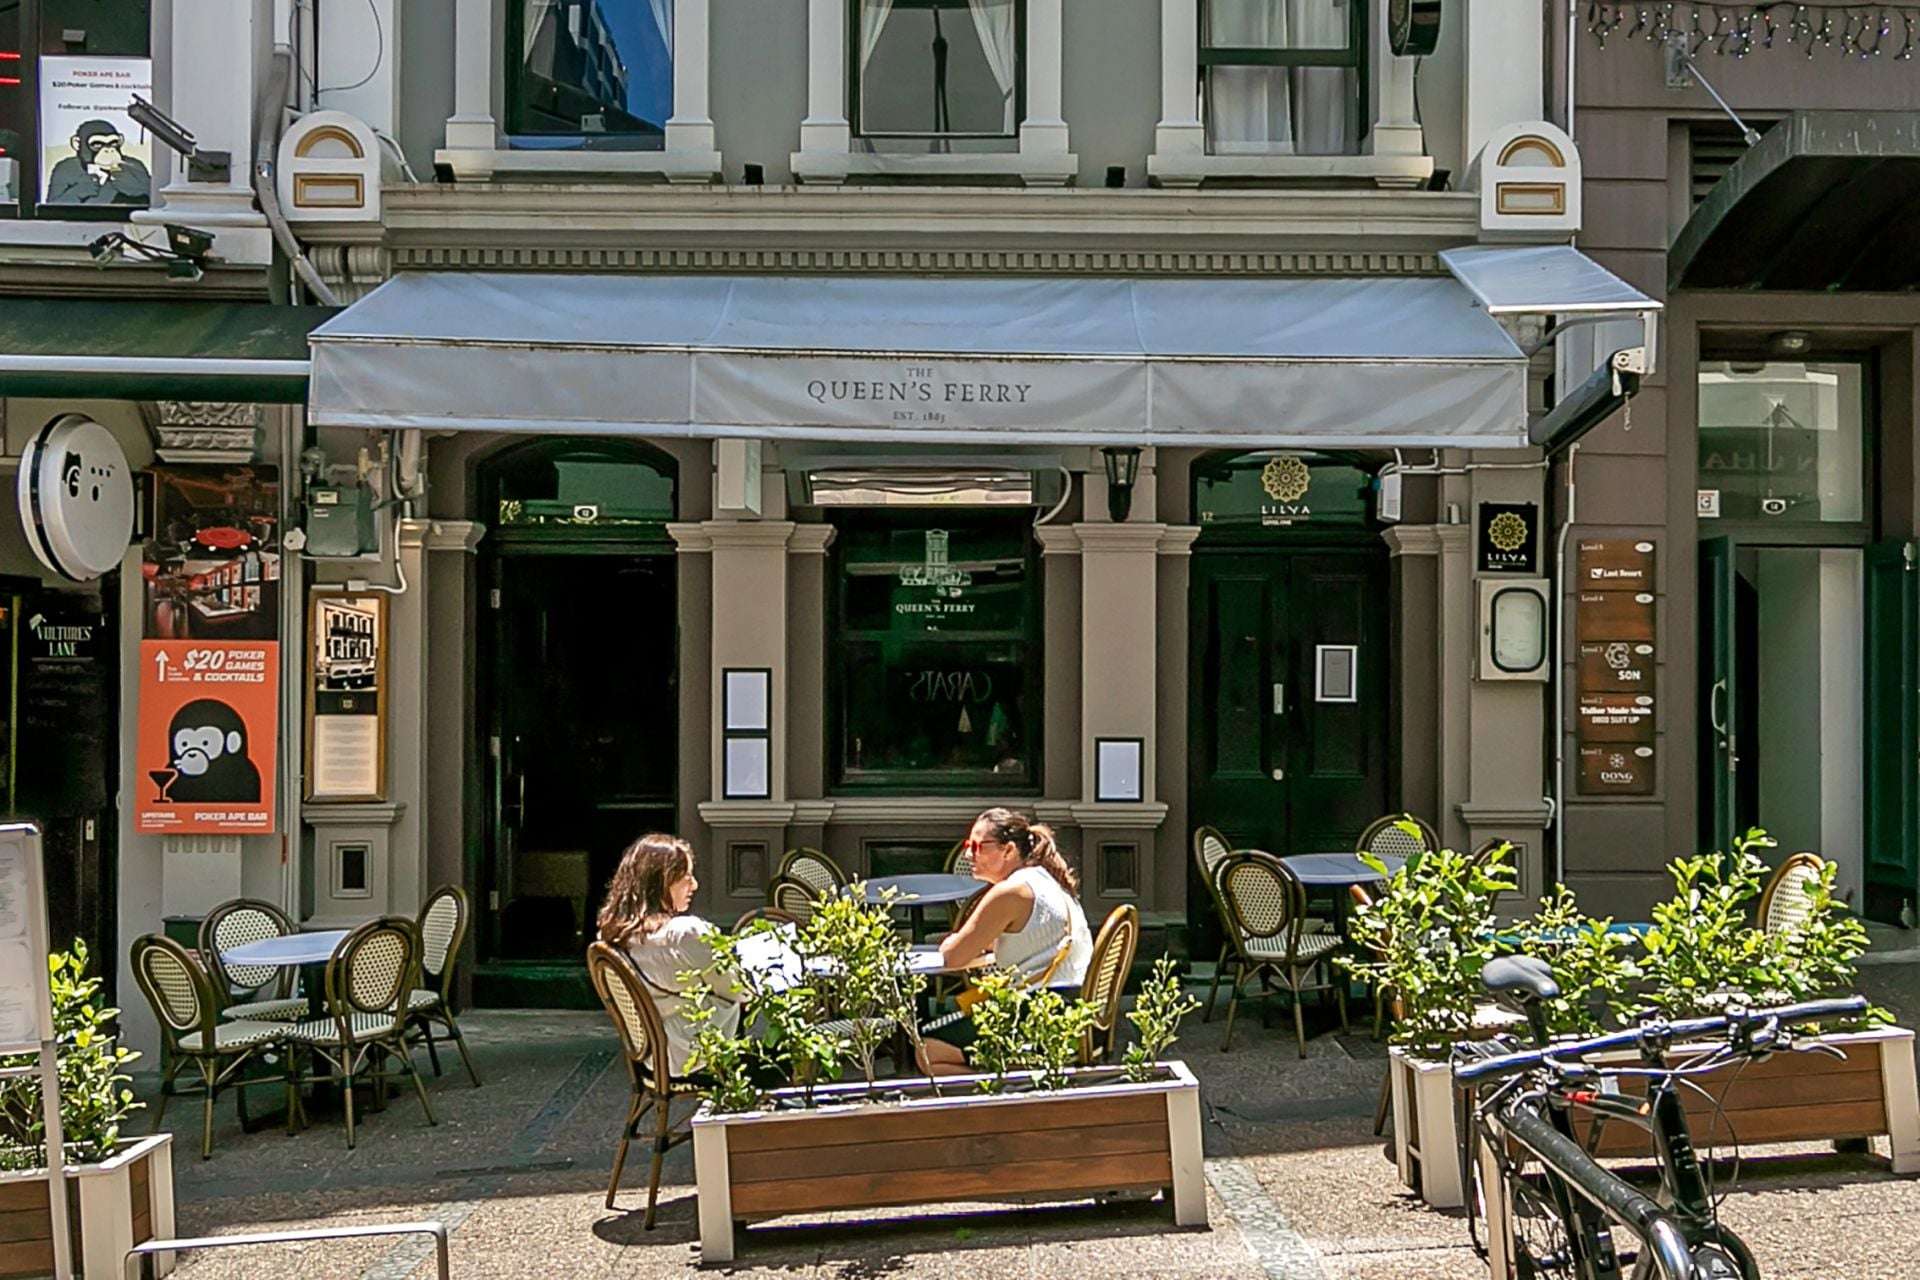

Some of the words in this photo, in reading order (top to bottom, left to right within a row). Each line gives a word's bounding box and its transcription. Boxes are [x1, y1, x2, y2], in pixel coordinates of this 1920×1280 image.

[907, 367, 933, 378] THE
[807, 379, 932, 403] QUEEN'S
[944, 383, 1031, 402] FERRY
[893, 411, 919, 421] EST.
[943, 604, 975, 613] FERRY
[49, 641, 78, 657] LANE
[183, 648, 226, 671] $20
[227, 650, 266, 660] POKER
[225, 660, 265, 671] GAMES
[192, 672, 203, 682] &
[204, 672, 265, 683] COCKTAILS
[194, 812, 226, 821] POKER
[227, 812, 246, 821] APE
[247, 812, 268, 821] BAR
